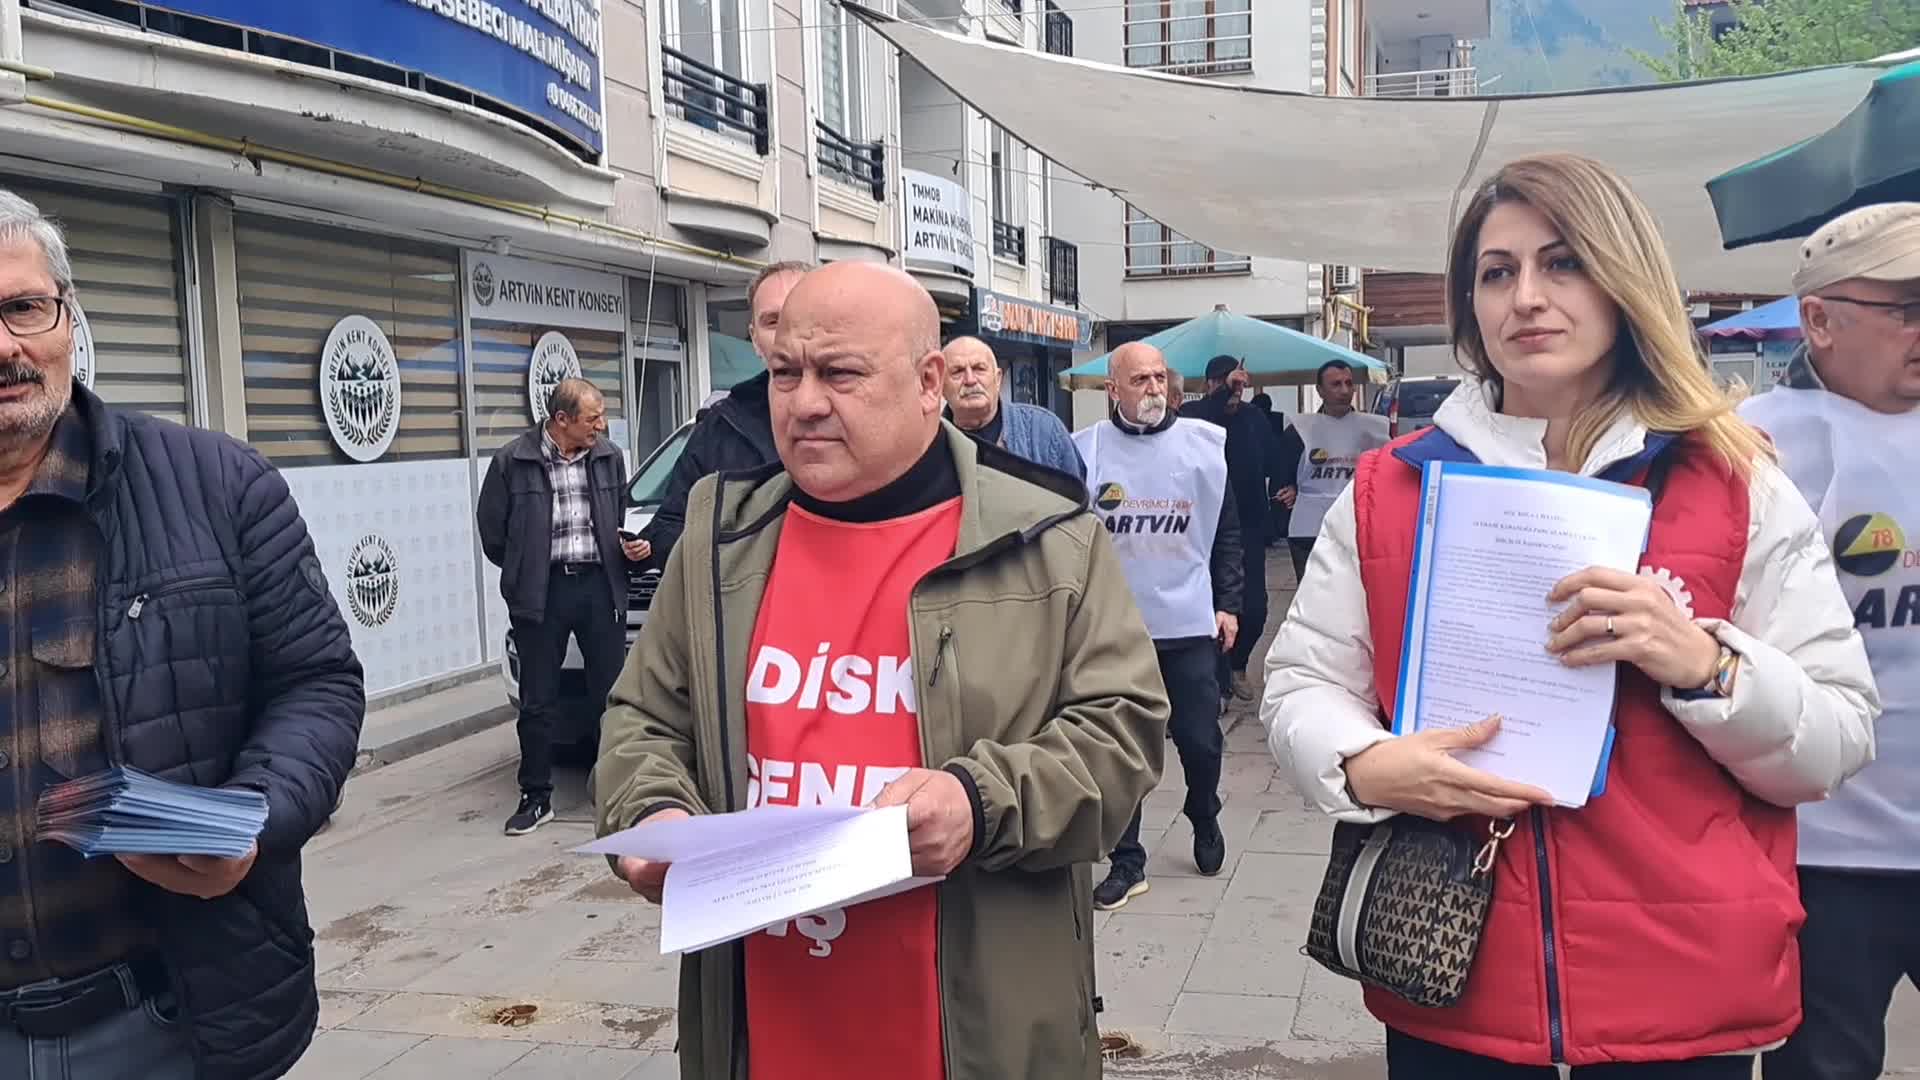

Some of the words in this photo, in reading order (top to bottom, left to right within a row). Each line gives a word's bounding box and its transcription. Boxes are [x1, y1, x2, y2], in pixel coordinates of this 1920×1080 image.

[912, 183, 941, 202] TMMOB
[913, 204, 949, 227] MAKİNA
[914, 231, 949, 252] ARTVİN
[499, 279, 543, 305] ARTVİN
[545, 285, 575, 310] KENT
[579, 289, 622, 315] KONSEYİ
[346, 329, 366, 345] KENT
[1105, 510, 1191, 534] ARTVİN
[361, 534, 376, 548] KENT
[1872, 529, 1893, 549] 78
[746, 642, 917, 715] DİSK
